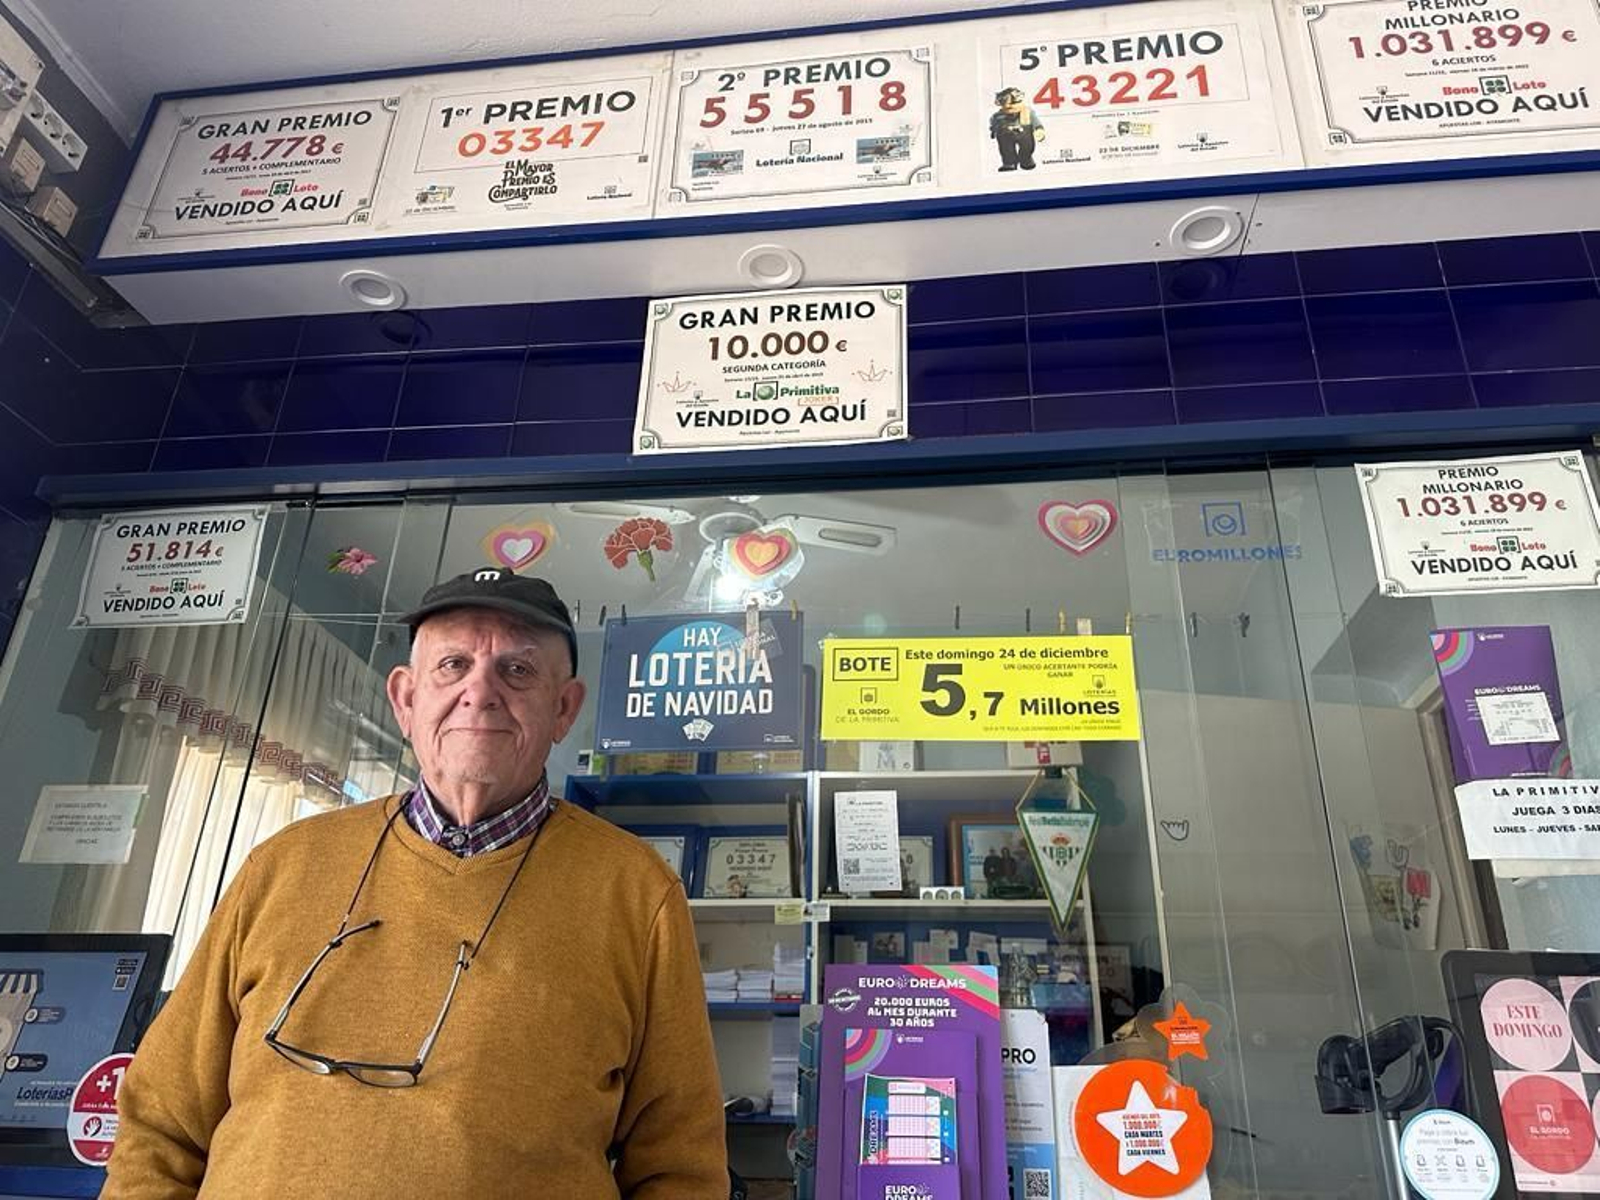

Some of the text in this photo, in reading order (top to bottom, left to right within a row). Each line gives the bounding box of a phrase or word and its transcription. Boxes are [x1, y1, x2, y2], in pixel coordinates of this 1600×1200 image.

[1385, 9, 1519, 31] MILLONARIO
[1057, 30, 1223, 67] PREMIO
[1349, 21, 1578, 59] 1.031.899 €
[1441, 54, 1496, 66] ACIERTOS
[763, 57, 892, 87] PREMIO
[1033, 64, 1210, 109] 43221
[1443, 80, 1546, 96] Bono Loto
[440, 90, 637, 128] 1er PREMIO
[1363, 87, 1590, 123] VENDIDO AQUÍ
[198, 110, 372, 140] GRAN PREMIO
[458, 121, 605, 158] 03347
[210, 135, 344, 164] 44.778 €
[796, 152, 844, 165] Nacional
[209, 164, 250, 175] ACIERTOS
[259, 157, 341, 171] COMPLEMENTARIO
[240, 183, 319, 197] Bono Loto
[175, 199, 274, 220] VENDIDO
[281, 190, 344, 213] AQUÍ
[679, 301, 876, 330] GRAN PREMIO
[709, 330, 847, 361] 10.000 €
[722, 359, 827, 374] SEGUNDA CATEGORÍA
[736, 384, 840, 399] La Primitiva
[676, 399, 867, 428] VENDIDO AQUÍ
[1438, 466, 1499, 480] PREMIO
[1422, 479, 1524, 494] MILLONARIO
[1397, 491, 1567, 518] 1.031.899 €
[117, 519, 246, 538] GRAN PREMIO
[1467, 518, 1509, 526] ACIERTOS
[126, 539, 212, 563] 51.814
[1521, 541, 1547, 550] Loto
[1411, 550, 1578, 575] VENDIDO AQUÍ
[103, 590, 225, 613] VENDIDO AQUÍ
[683, 626, 722, 647] HAY
[905, 647, 1109, 663] Este domingo 24 de diciembre
[839, 657, 891, 672] BOTE
[626, 689, 773, 718] DE NAVIDAD
[1020, 698, 1120, 716] Millones
[1493, 788, 1510, 797] LA
[1512, 807, 1556, 817] JUEGA
[1562, 806, 1570, 815] 3
[1493, 826, 1526, 834] LUNES
[1536, 825, 1576, 834] JUEVES
[858, 977, 966, 989] EURO DREAMS
[874, 997, 951, 1008] 20.000 EUROS
[867, 1007, 957, 1018] AL MES DURANTE
[1507, 1005, 1541, 1020] ESTE
[889, 1016, 935, 1028] 30 AÑOS
[1493, 1022, 1563, 1038] DOMINGO
[885, 1184, 917, 1196] EURO
